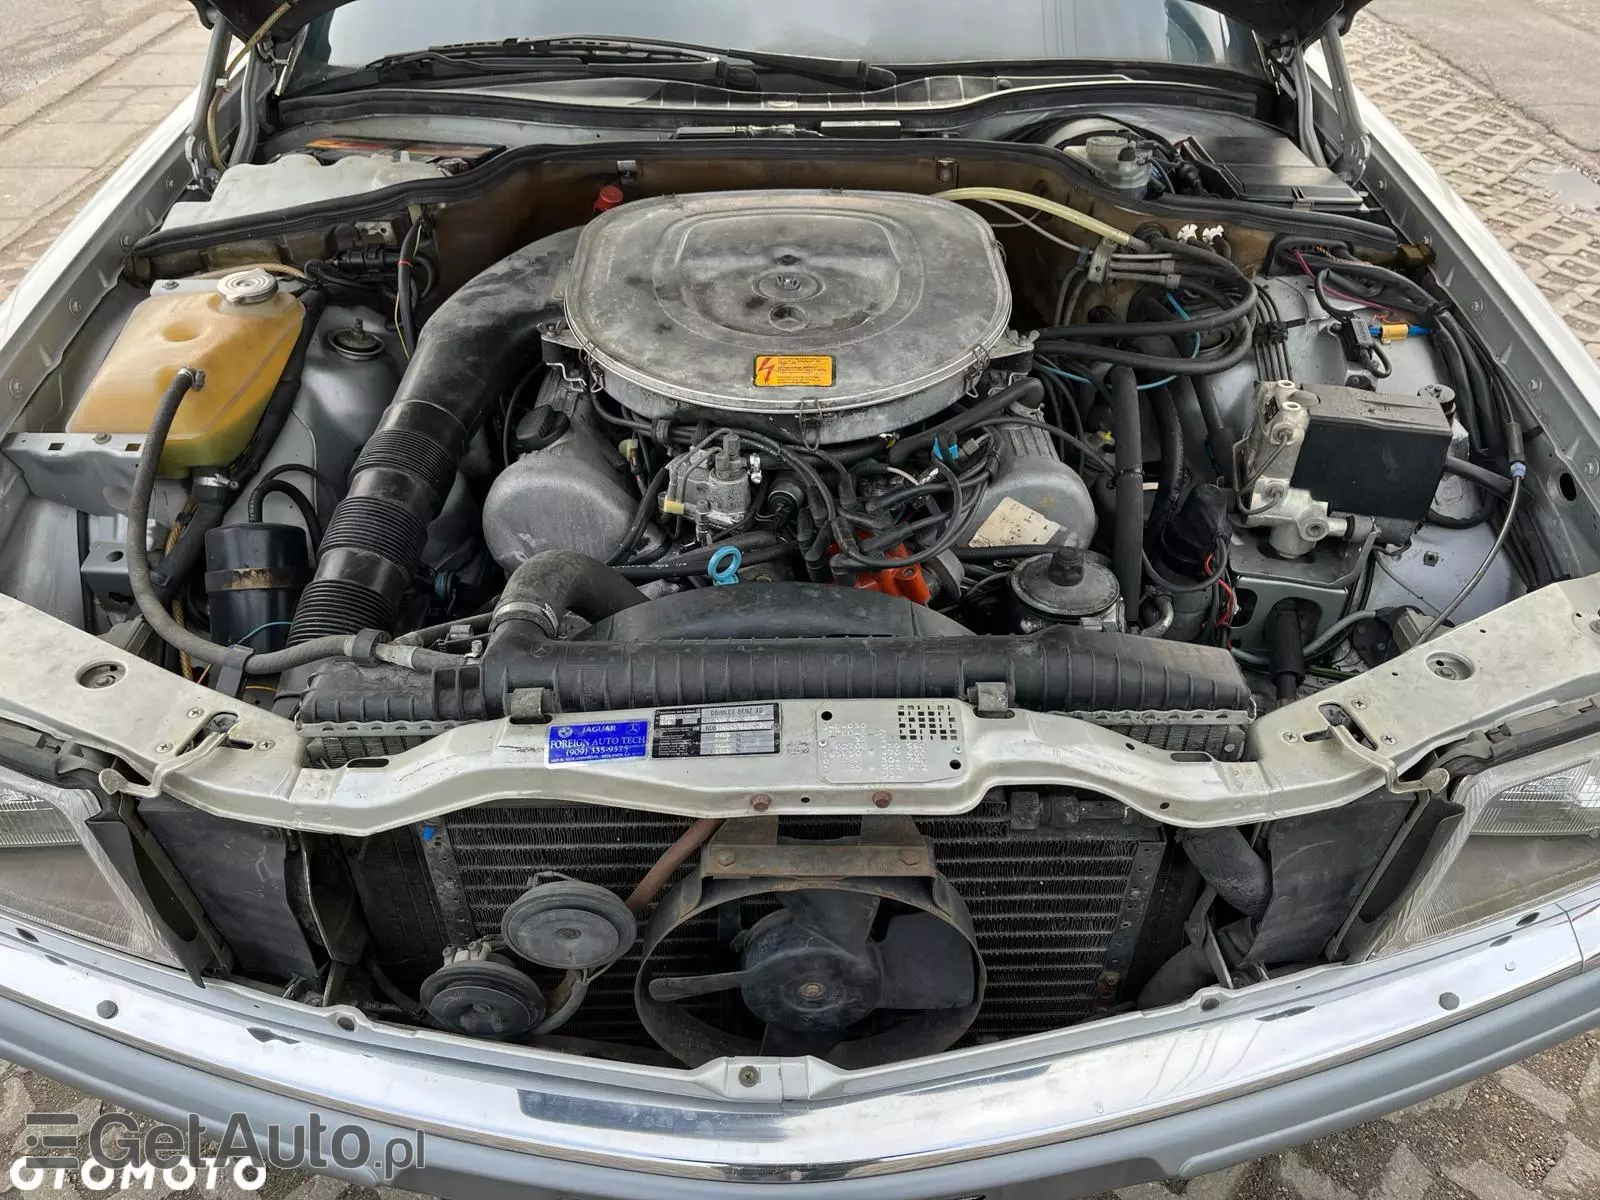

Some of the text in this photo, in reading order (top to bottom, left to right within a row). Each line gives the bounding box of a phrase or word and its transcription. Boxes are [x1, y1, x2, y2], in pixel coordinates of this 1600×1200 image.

[582, 725, 617, 734] JAGUAR
[550, 735, 646, 750] FOREIGN AUTO TECH
[566, 747, 588, 757] (909)
